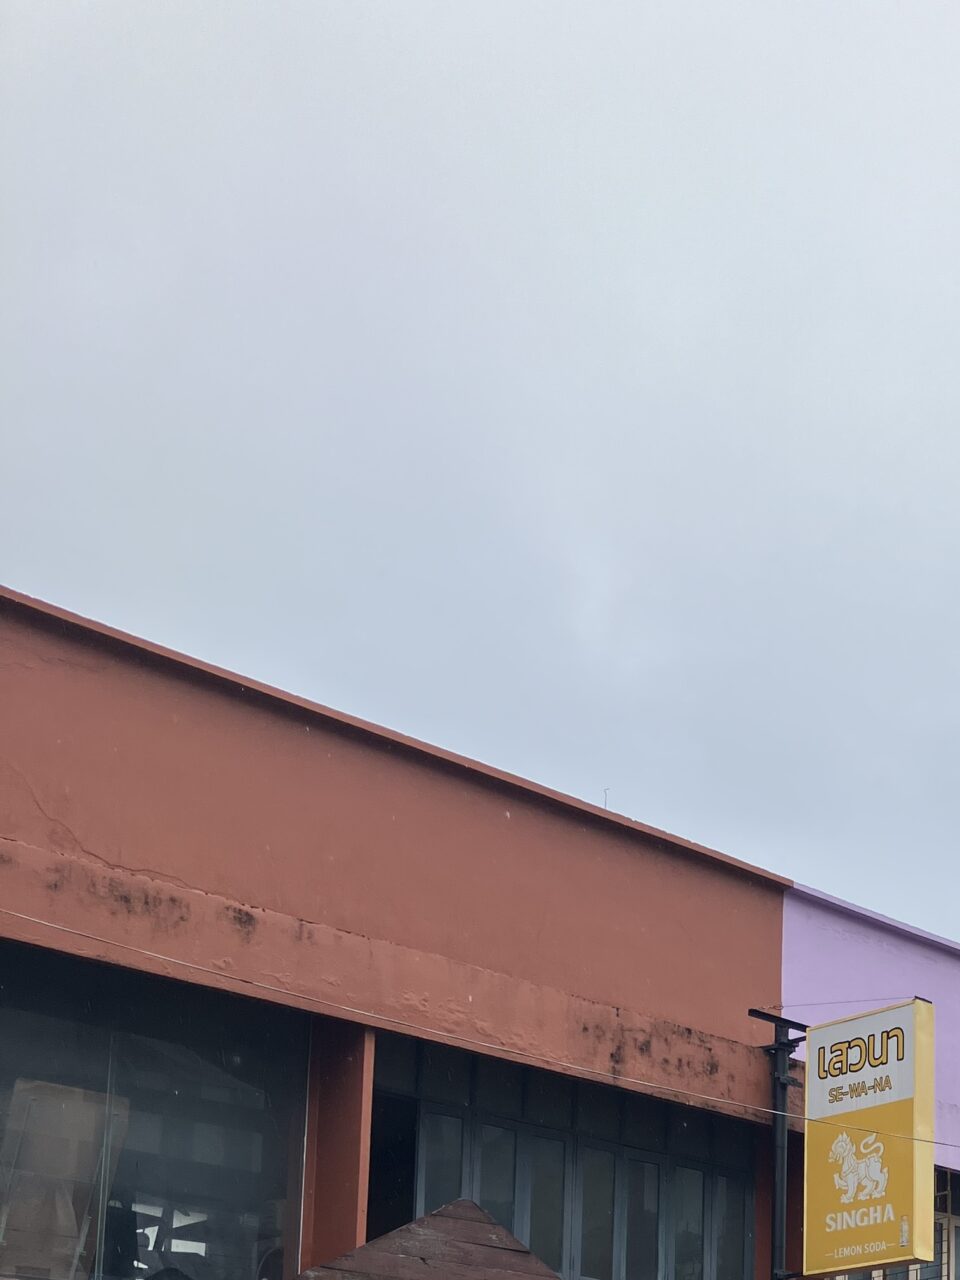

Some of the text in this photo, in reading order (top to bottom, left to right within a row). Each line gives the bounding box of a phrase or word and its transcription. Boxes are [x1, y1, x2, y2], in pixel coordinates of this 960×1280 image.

[818, 1027, 905, 1079] เสวนา
[828, 1075, 893, 1103] SE-WA-NA
[825, 1203, 896, 1232] SINGHA
[834, 1240, 887, 1259] LEMON SODA
